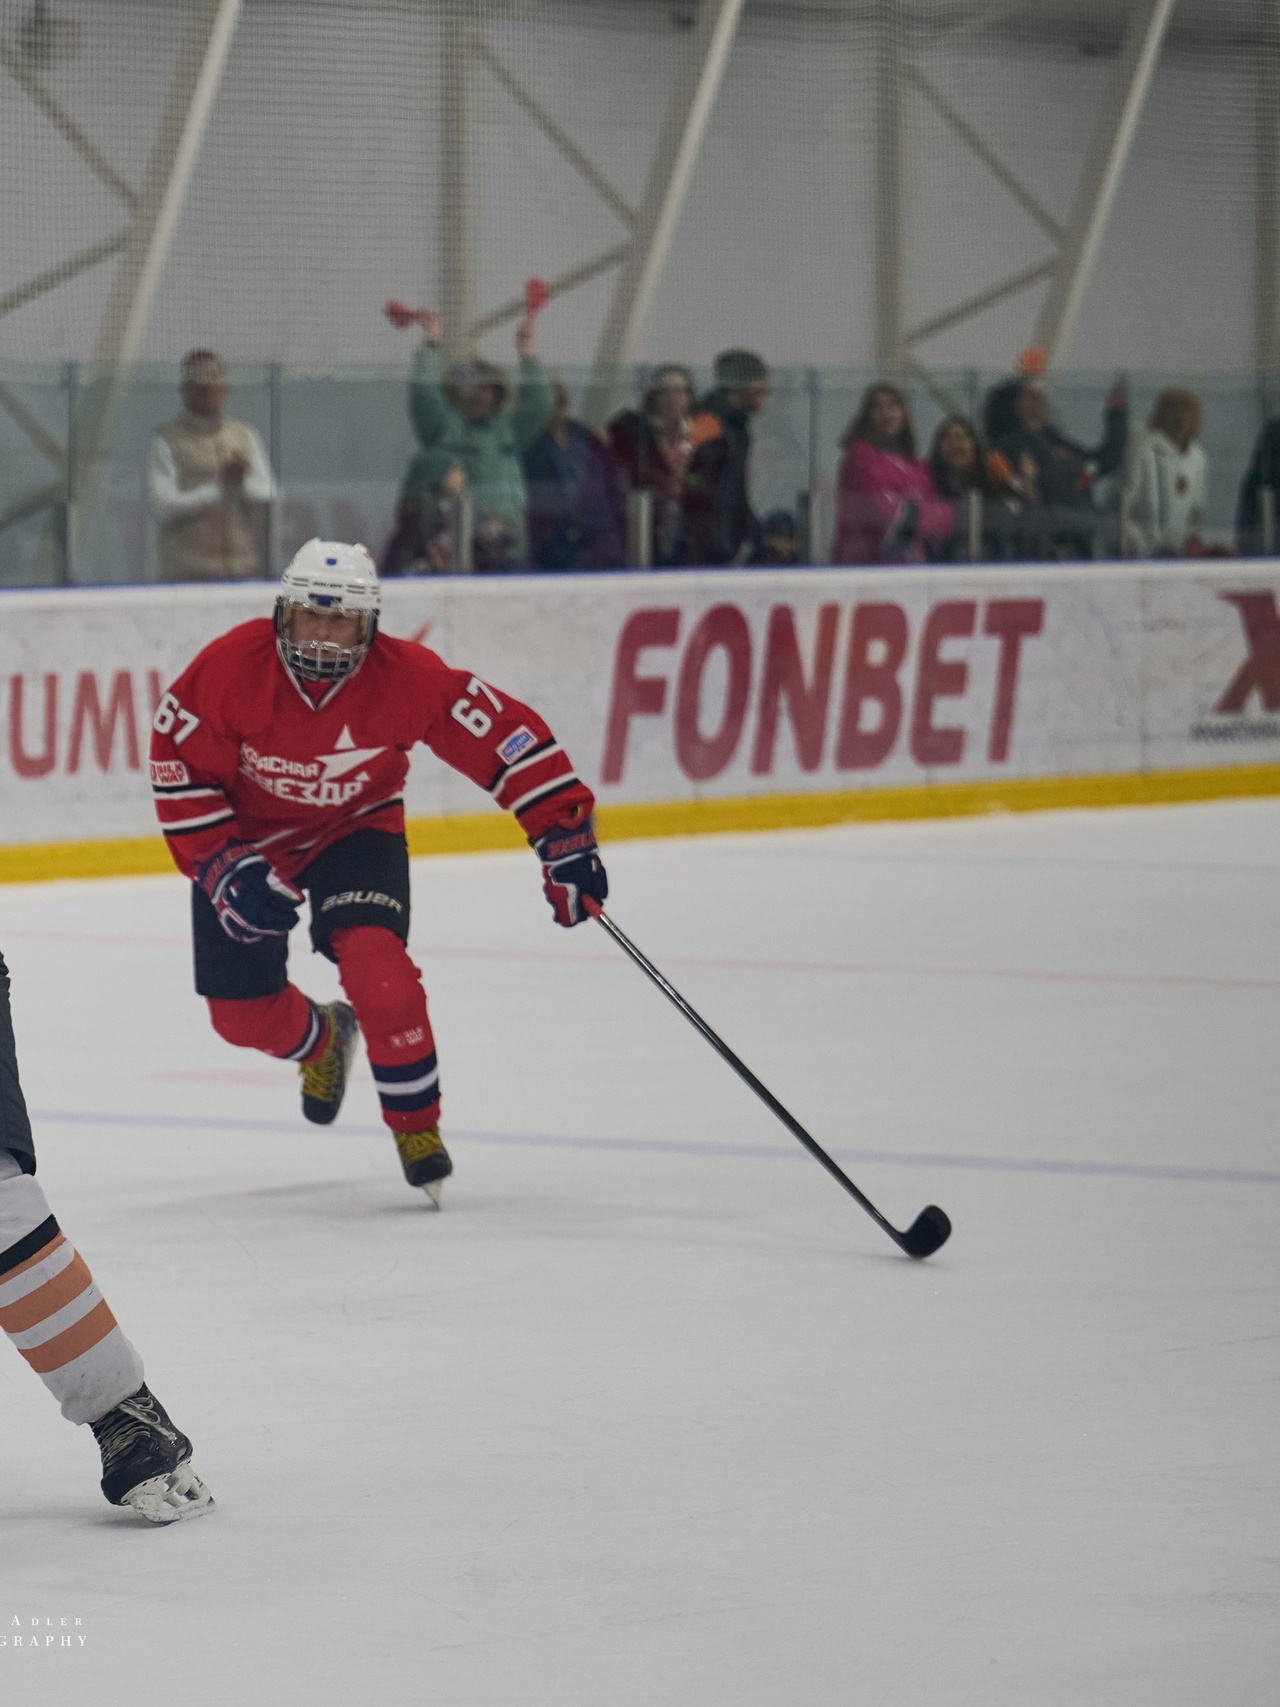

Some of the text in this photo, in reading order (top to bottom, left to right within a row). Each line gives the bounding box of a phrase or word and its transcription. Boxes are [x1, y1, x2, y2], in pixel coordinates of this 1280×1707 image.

[153, 691, 201, 745] 67
[451, 676, 503, 738] 67
[599, 598, 1046, 784] FONBET
